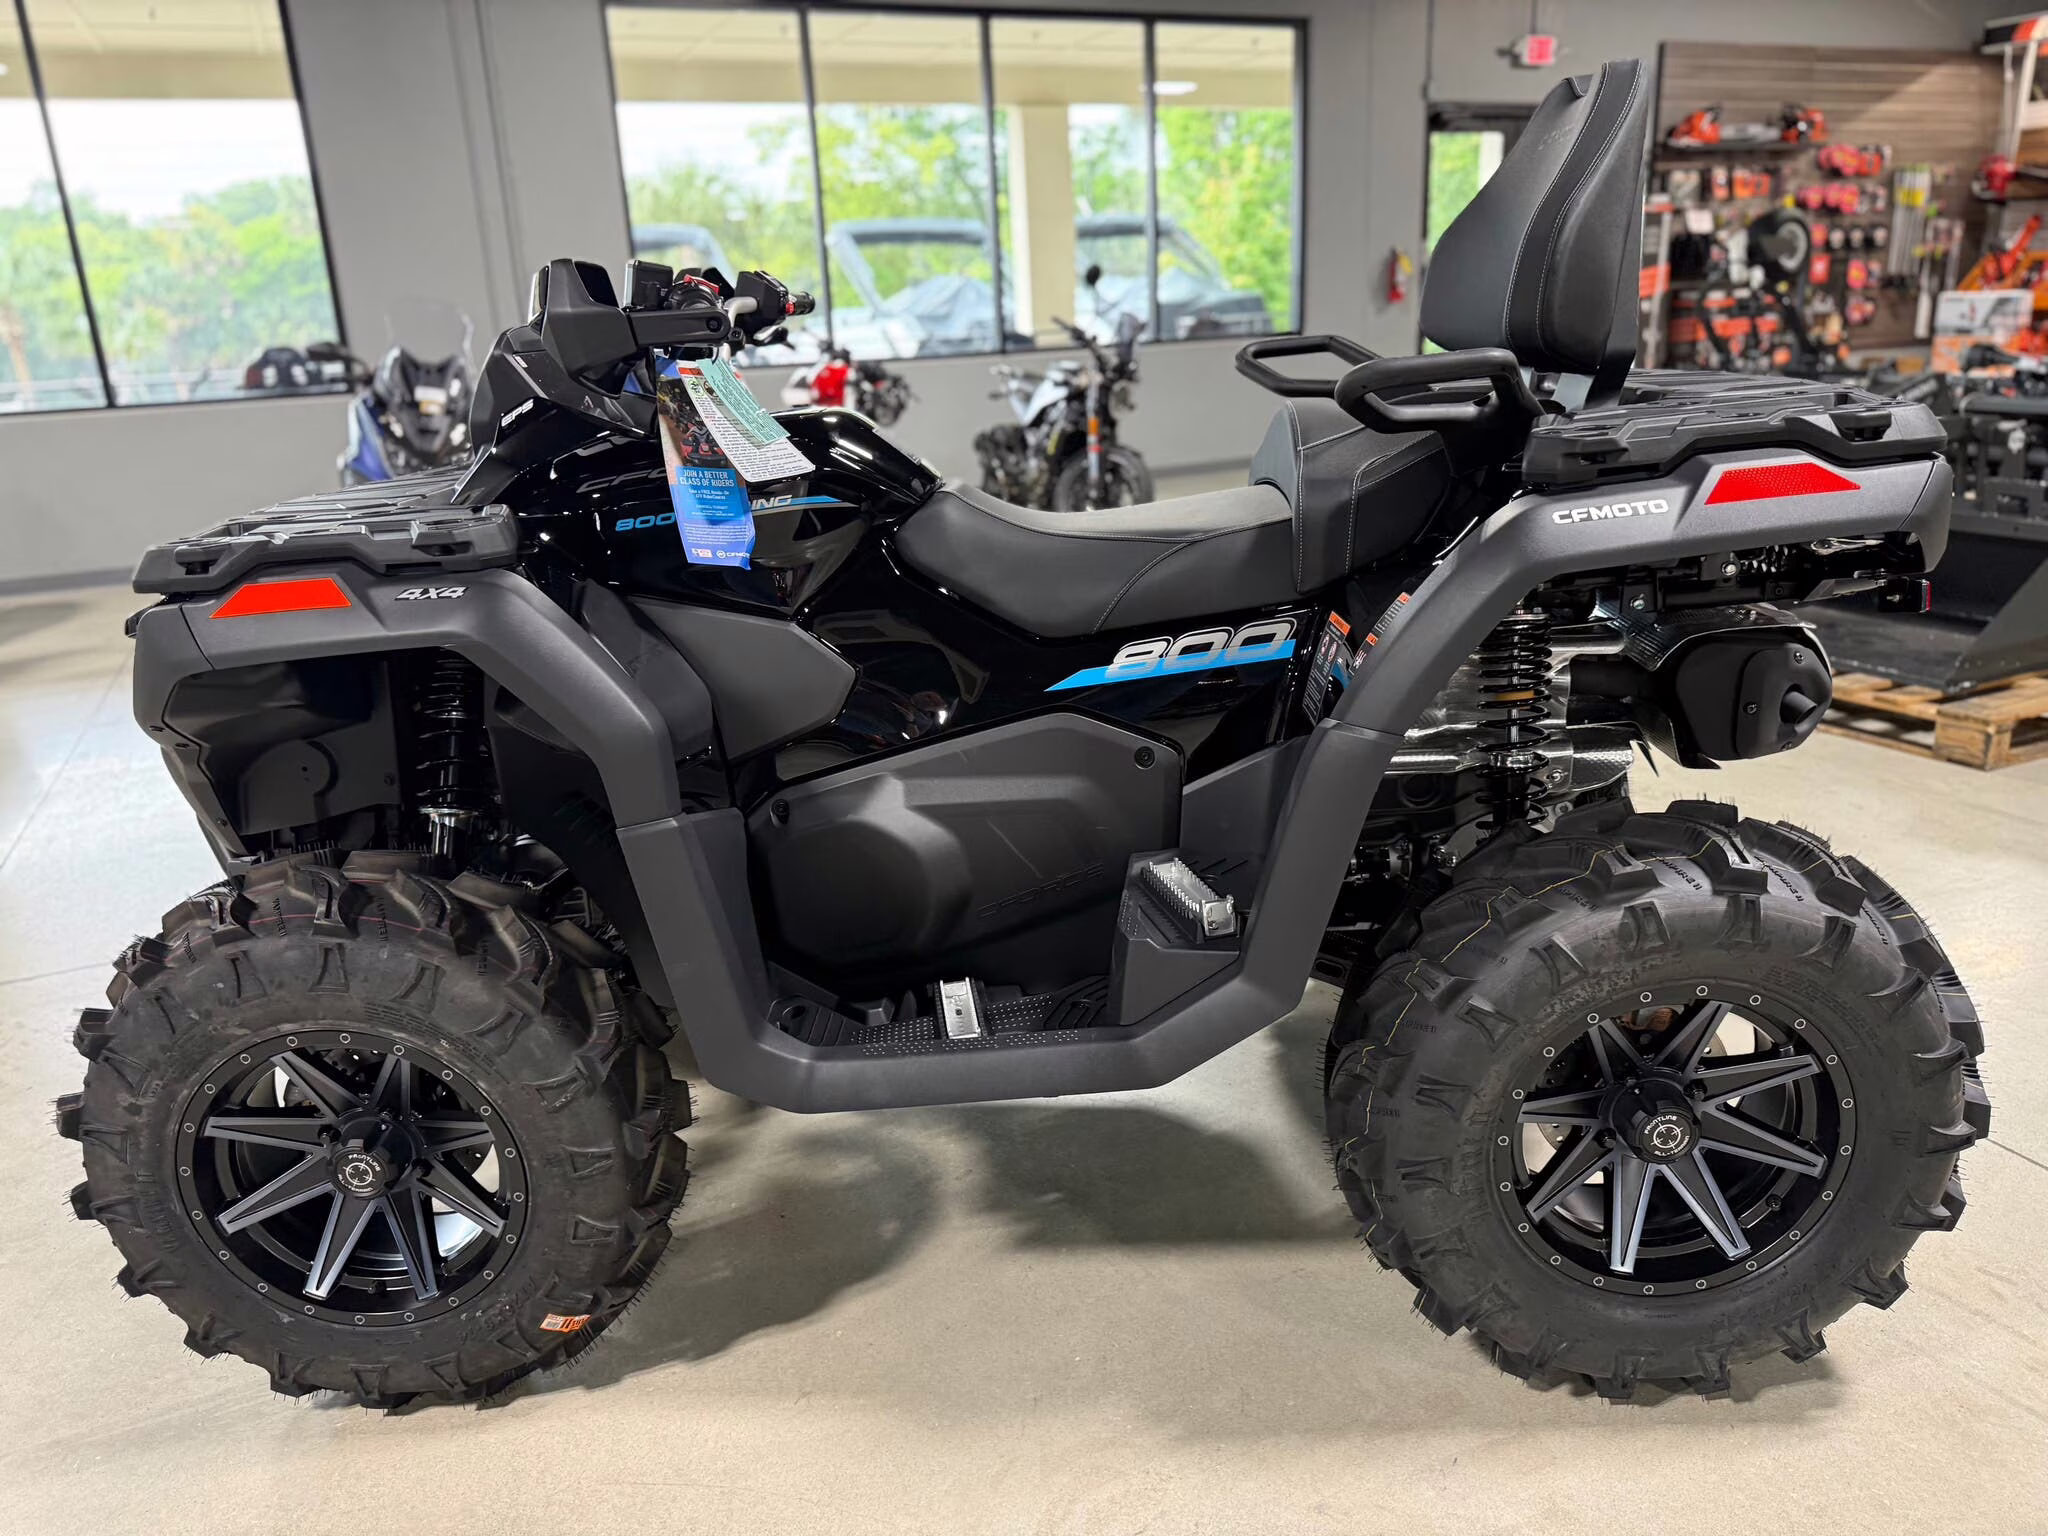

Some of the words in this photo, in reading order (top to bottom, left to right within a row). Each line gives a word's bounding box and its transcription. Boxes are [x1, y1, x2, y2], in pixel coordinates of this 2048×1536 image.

[501, 399, 534, 427] EPS
[680, 477, 701, 486] CLASS
[702, 478, 710, 487] OF
[711, 479, 735, 487] RIDERS
[683, 470, 698, 478] JOIN
[704, 471, 729, 479] BETTER
[615, 512, 676, 532] 800
[751, 494, 793, 510] ING
[1552, 499, 1670, 525] CFMOTO
[1105, 618, 1298, 679] 800
[1644, 1115, 1677, 1135] FRONTLINE
[1654, 1135, 1690, 1156] ALL-TERRAIN
[348, 1154, 381, 1172] FRONTLINE
